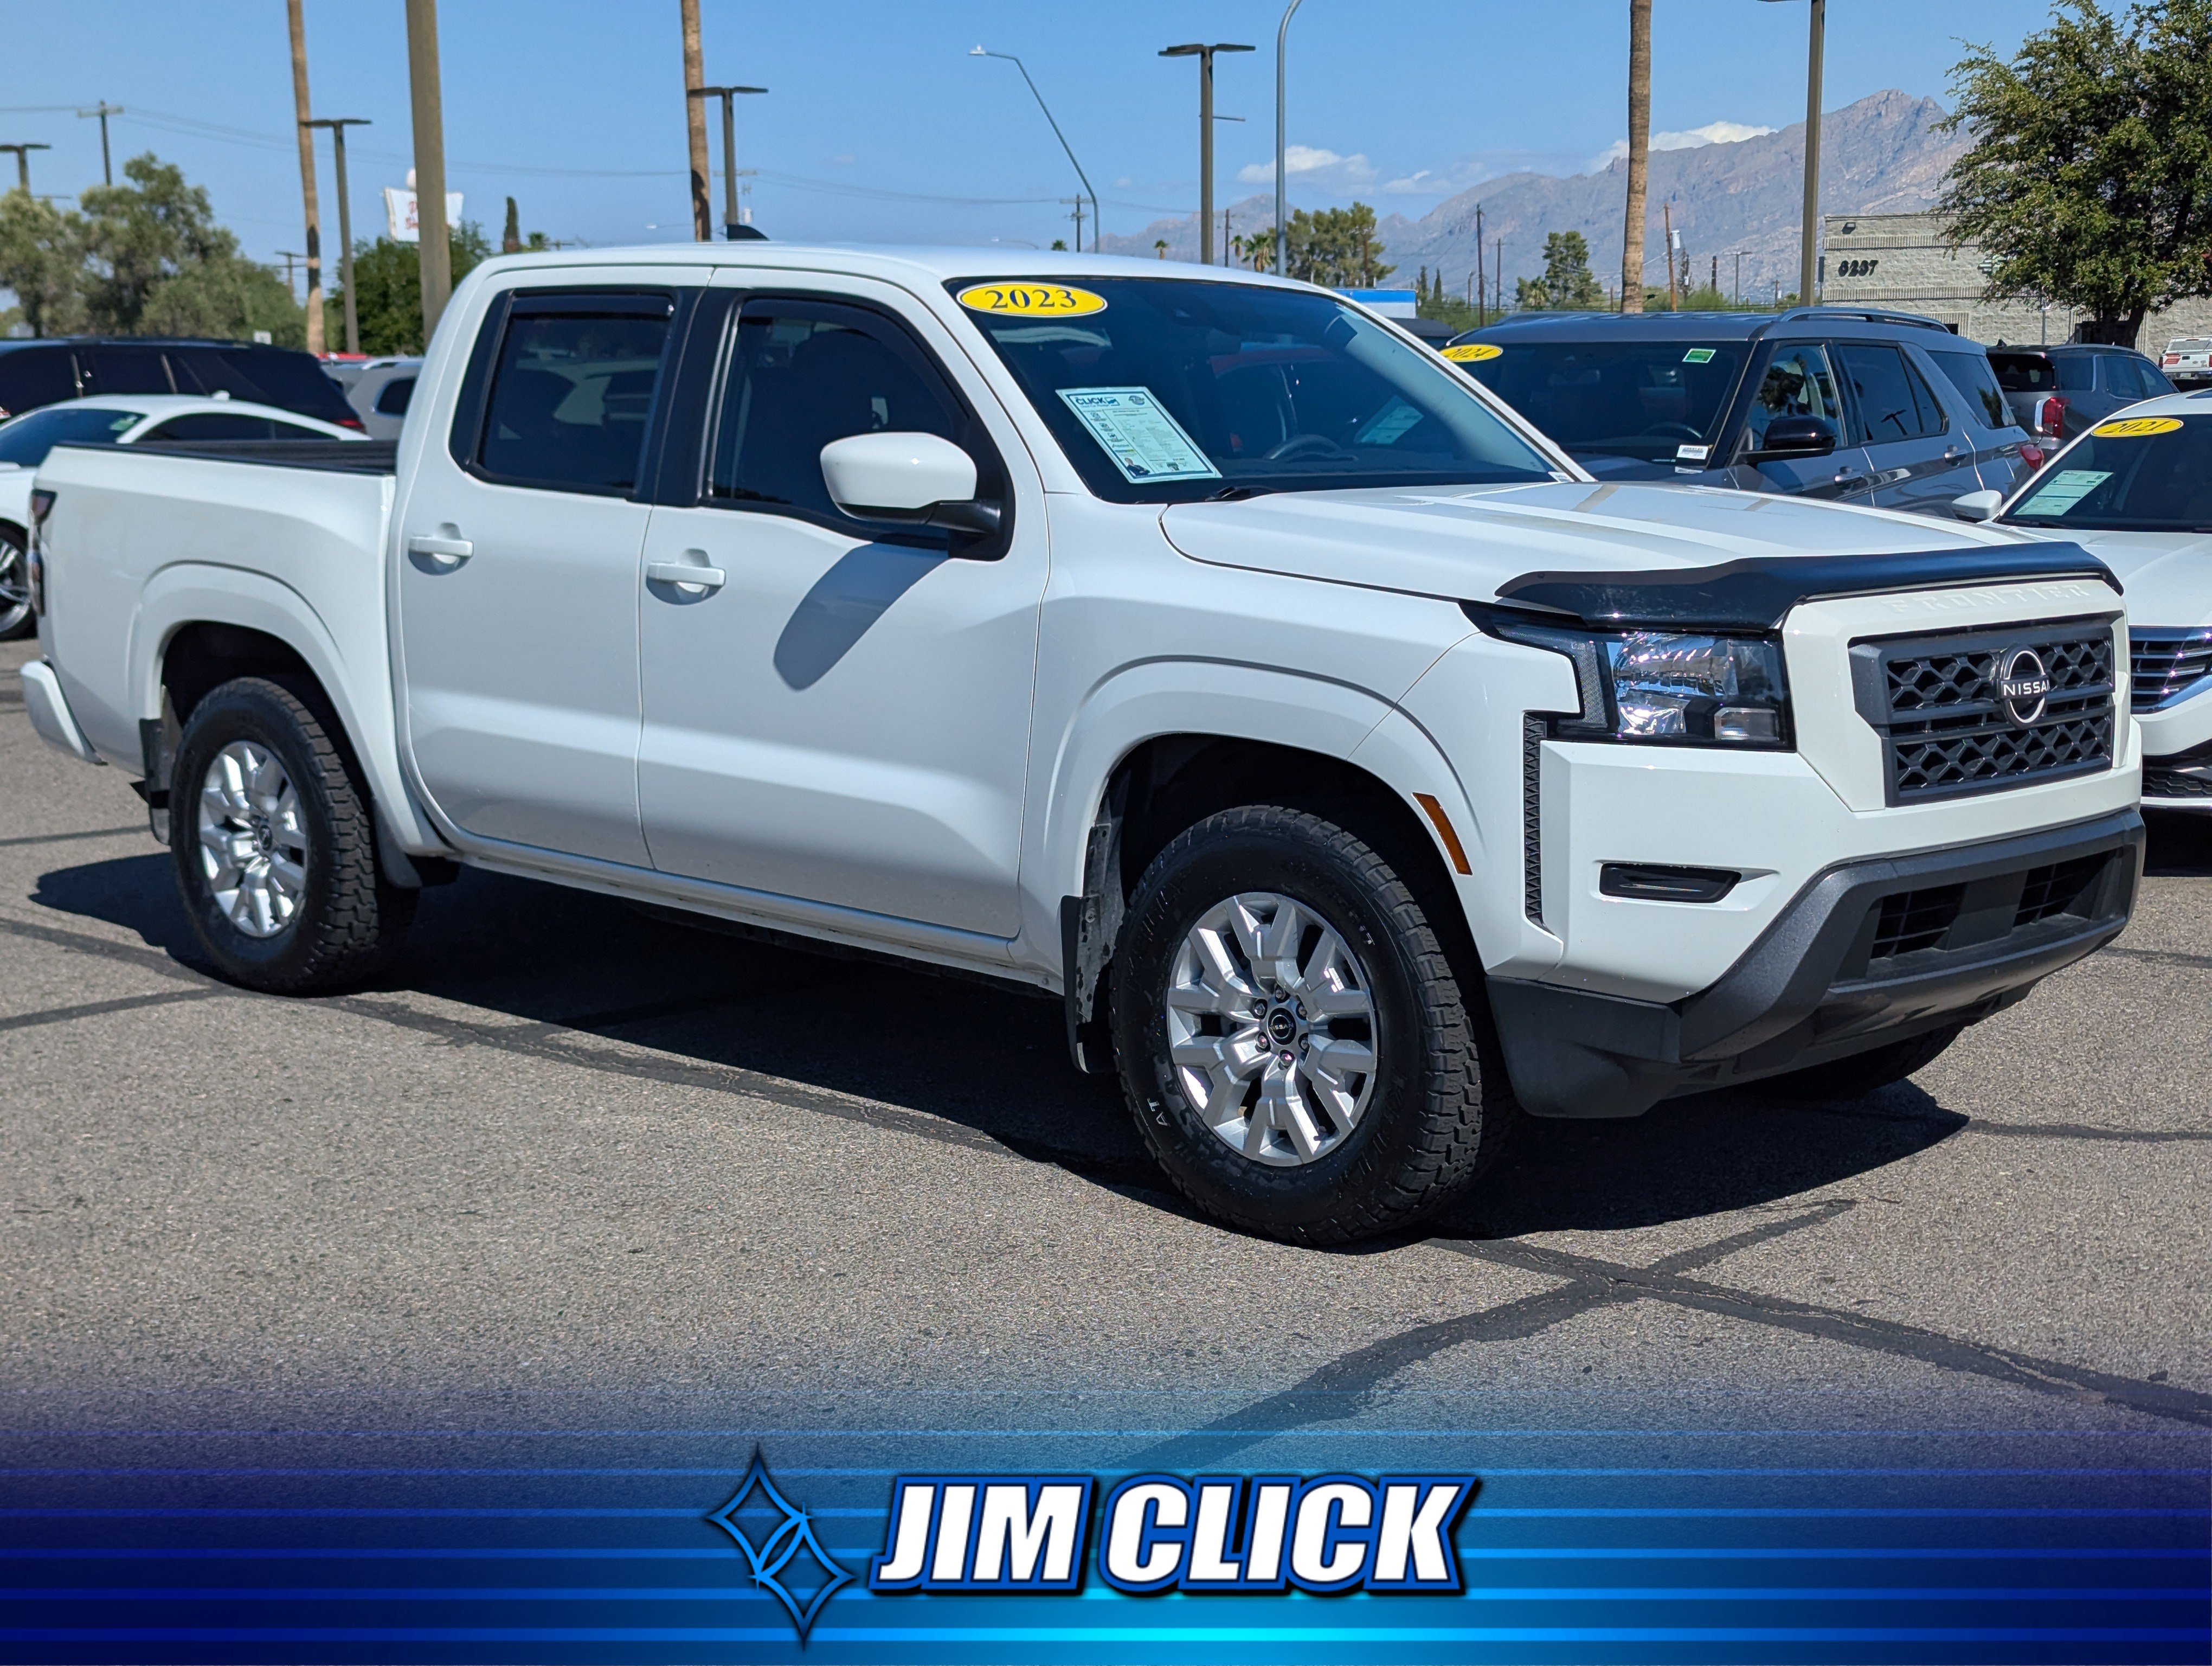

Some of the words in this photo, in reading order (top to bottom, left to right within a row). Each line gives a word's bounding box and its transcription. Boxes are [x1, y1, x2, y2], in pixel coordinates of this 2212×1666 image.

[985, 289, 1076, 309] 2023
[1443, 348, 1494, 358] 2024
[1076, 397, 1107, 405] CLICK
[2102, 421, 2171, 434] 2021
[1881, 585, 2091, 613] FRONTIER
